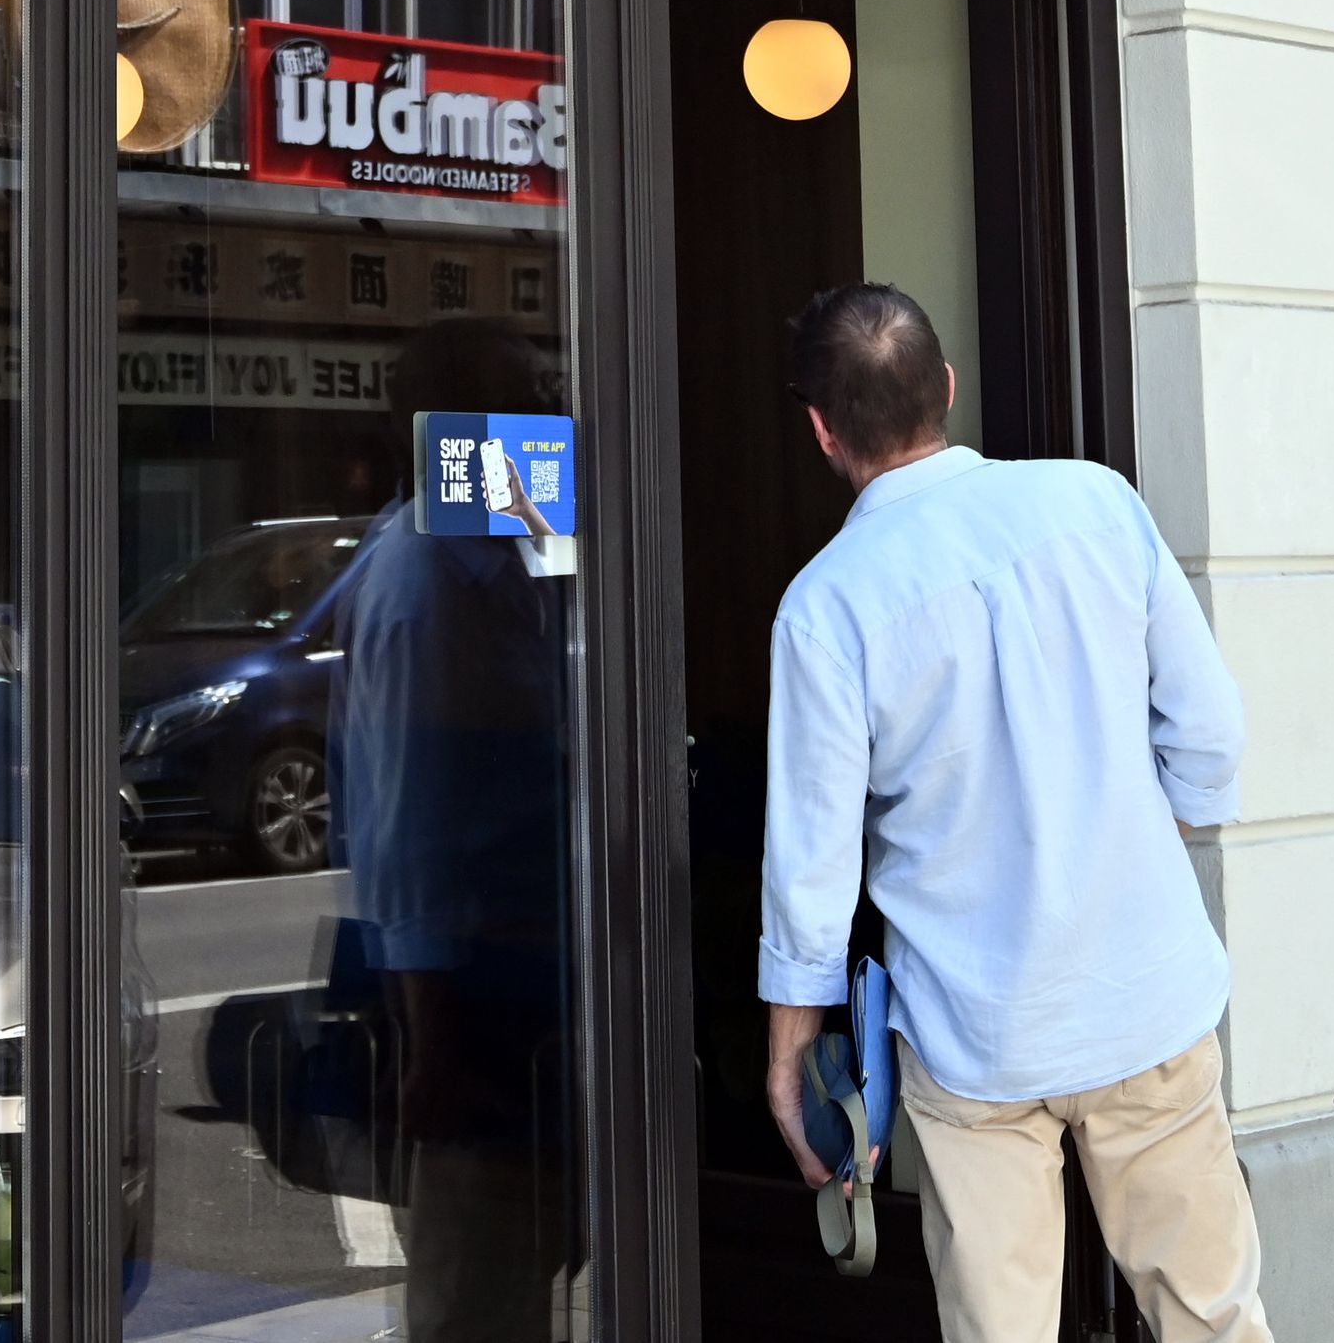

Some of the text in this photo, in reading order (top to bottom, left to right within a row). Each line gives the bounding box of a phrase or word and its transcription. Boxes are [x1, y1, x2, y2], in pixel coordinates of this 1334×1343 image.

[440, 438, 475, 459] SKIP
[522, 441, 566, 453] GET THE APP
[440, 460, 469, 481] THE
[441, 482, 473, 503] LINE
